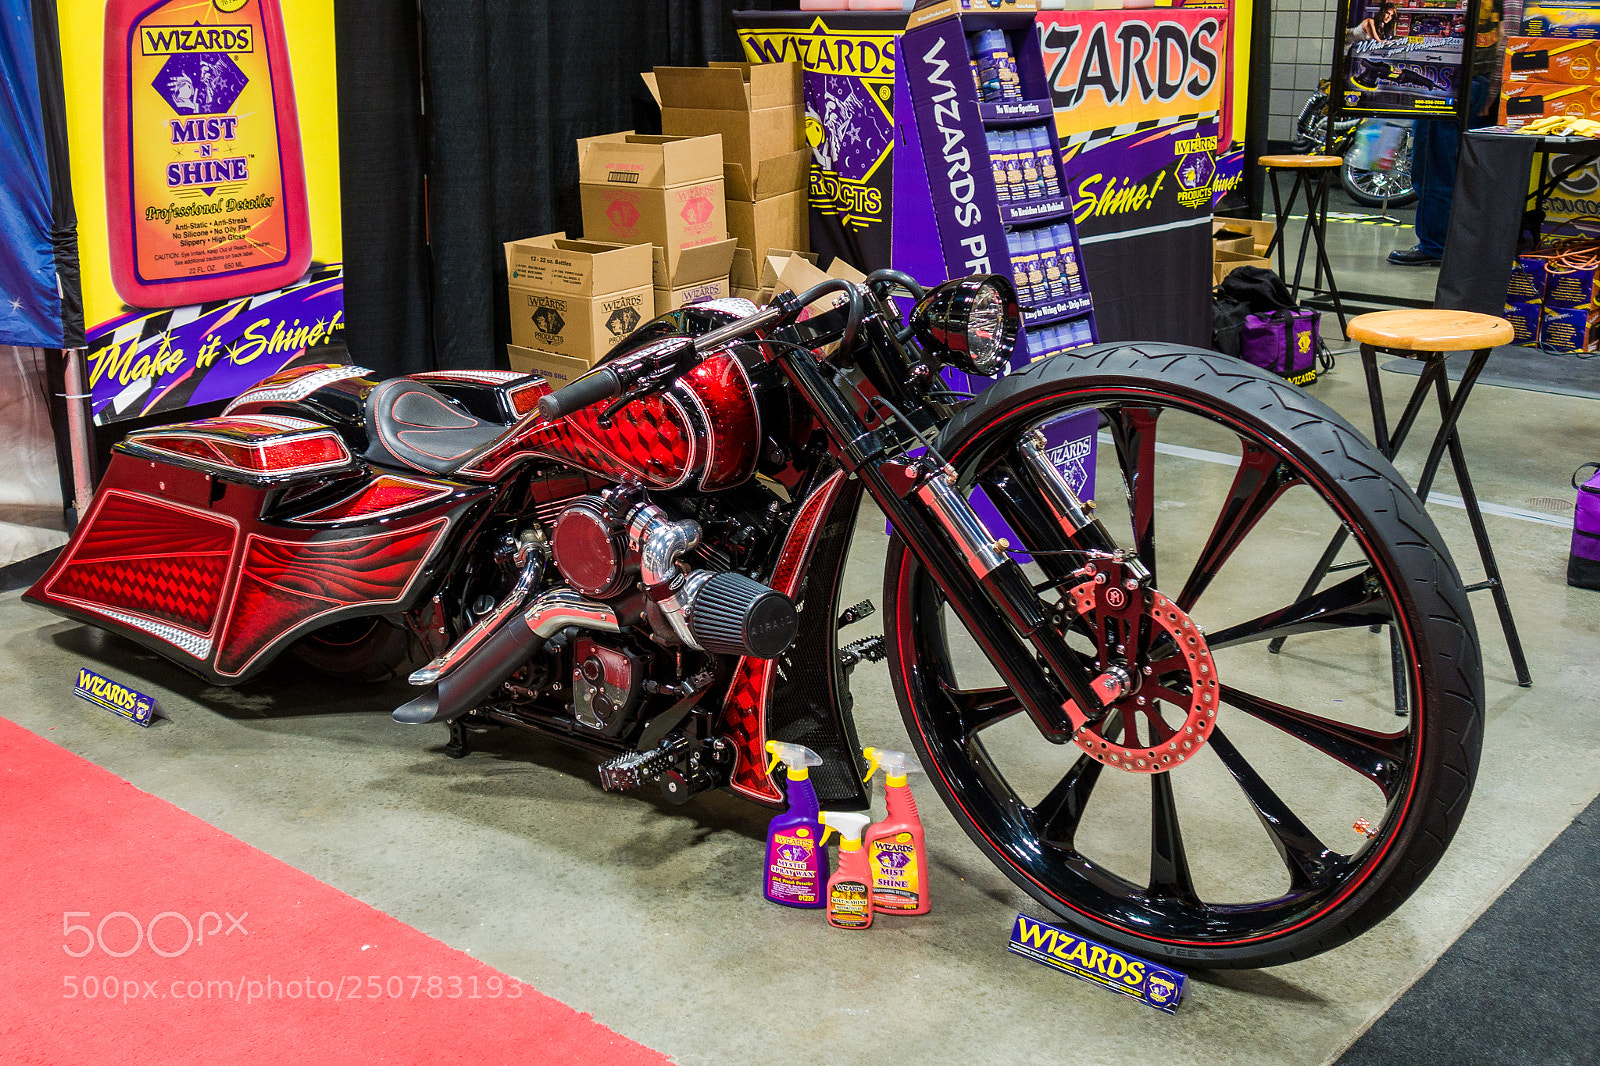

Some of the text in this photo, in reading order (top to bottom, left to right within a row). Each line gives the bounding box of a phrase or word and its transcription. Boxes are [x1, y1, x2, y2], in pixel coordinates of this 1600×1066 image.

[146, 29, 249, 51] WIZARDS
[746, 36, 895, 75] WIZARDS
[1037, 17, 1219, 112] ZARDS
[995, 103, 1040, 114] No Water Spotting
[171, 117, 237, 143] MIST
[922, 36, 981, 228] WIZARDS
[167, 158, 248, 186] SHINE
[1212, 170, 1242, 192] hine!
[678, 185, 714, 201] WIZARDS
[1073, 170, 1166, 224] Shine!
[146, 194, 274, 224] Professional Detailer
[1010, 201, 1065, 217] No Residue Left Behind
[175, 217, 248, 231] Anti-Static Anti-Streak
[183, 230, 208, 238] Silicone
[225, 226, 236, 234] Oily
[238, 224, 251, 232] Film
[180, 233, 246, 247] Slippery High Gloss
[184, 257, 205, 265] additional
[554, 259, 572, 267] Bottles
[683, 285, 719, 300] WIZARDS
[529, 296, 566, 311] WIZARDS
[602, 296, 642, 312] WIZARDS
[1042, 306, 1057, 316] Wring
[1057, 304, 1066, 313] Out
[1069, 300, 1080, 310] Drip
[1080, 298, 1091, 307] Free
[534, 332, 564, 343] PRODUCTS
[88, 310, 343, 390] Make it Shine!
[80, 670, 137, 710] WIZARDS
[777, 836, 811, 847] WIZARDS
[875, 842, 914, 852] WIZARDS
[771, 865, 815, 878] SPRAY WAX
[777, 859, 806, 869] MYSTIC
[880, 868, 905, 876] MIST
[835, 884, 864, 892] WIZARDS
[878, 878, 908, 888] SHINE
[1018, 918, 1144, 985] WIZARDS
[1163, 946, 1198, 957] VEE
